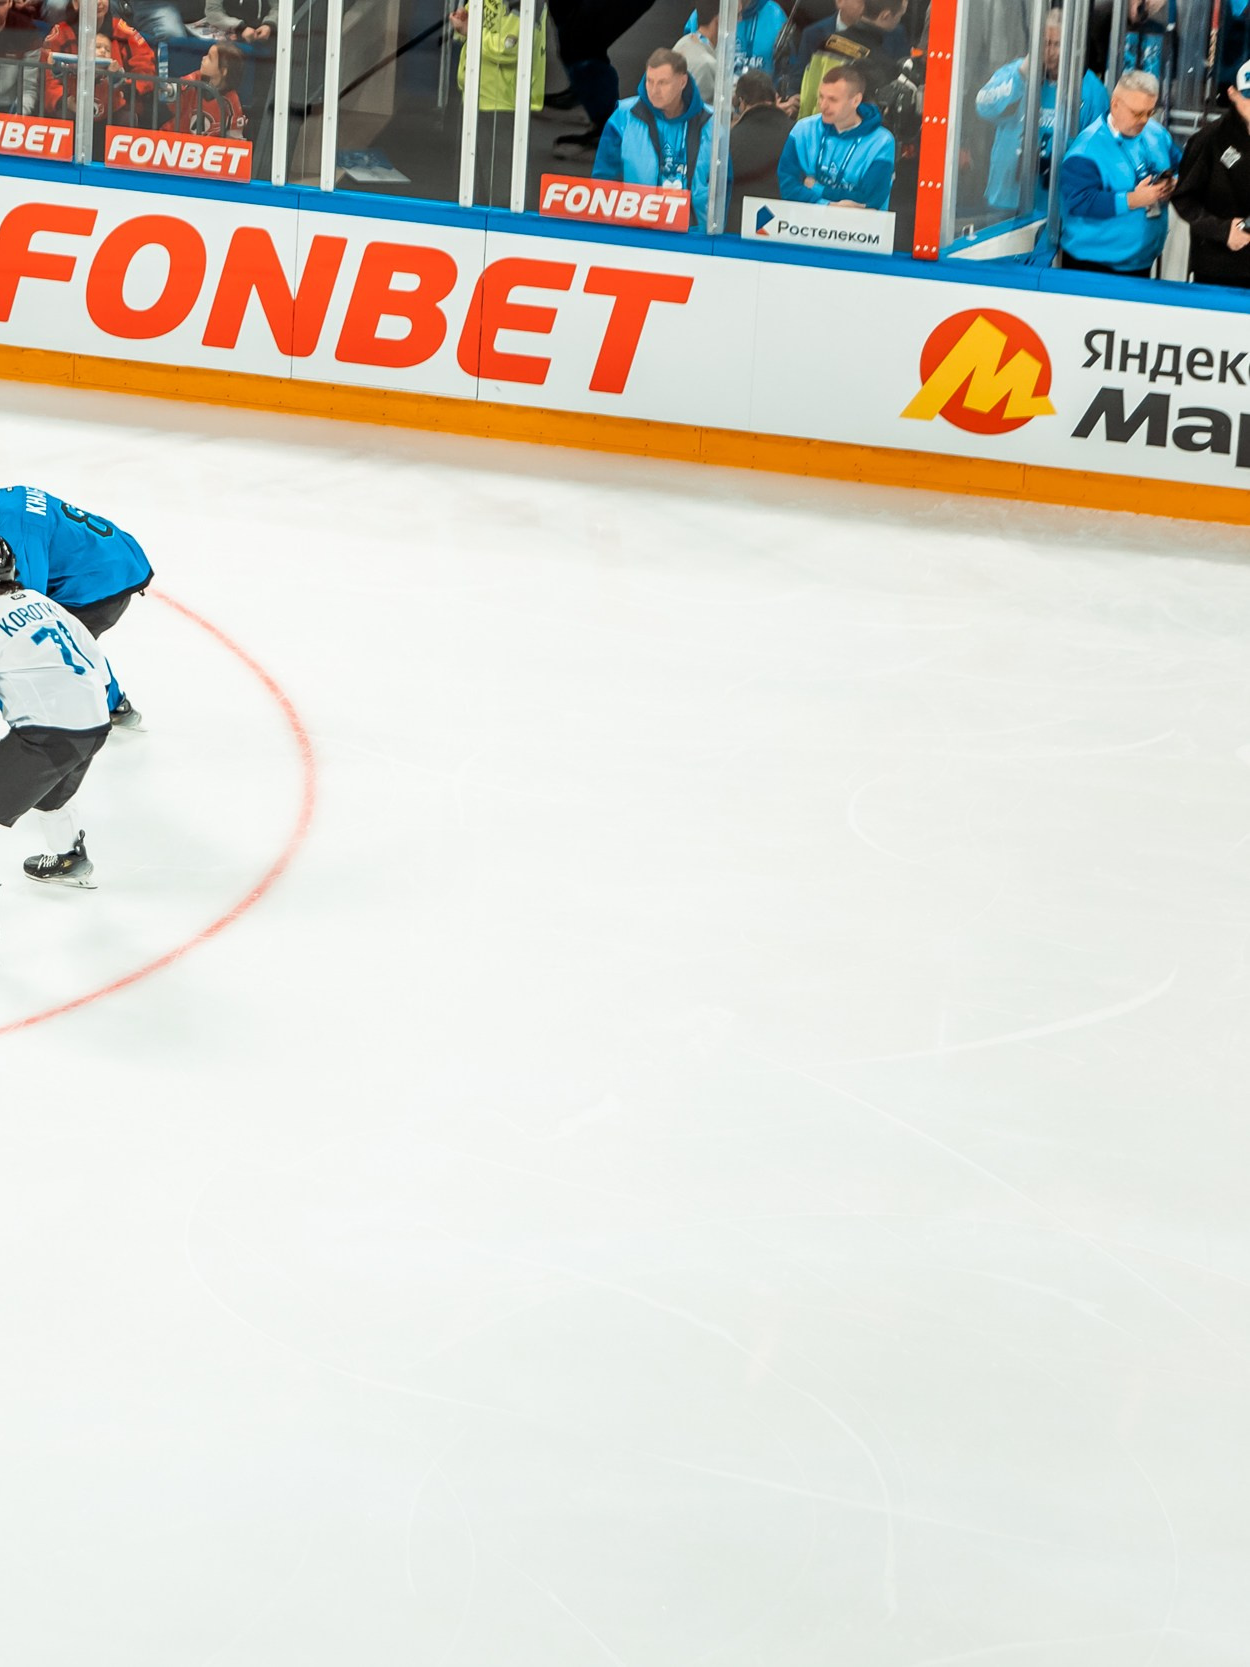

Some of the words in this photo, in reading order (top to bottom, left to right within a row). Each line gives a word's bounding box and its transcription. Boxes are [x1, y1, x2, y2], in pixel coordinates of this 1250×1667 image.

[108, 134, 250, 175] FONBET
[542, 183, 688, 224] FONBET
[777, 220, 881, 246] Ростелеком
[1081, 328, 1250, 386] Яндек
[30, 620, 95, 676] 71
